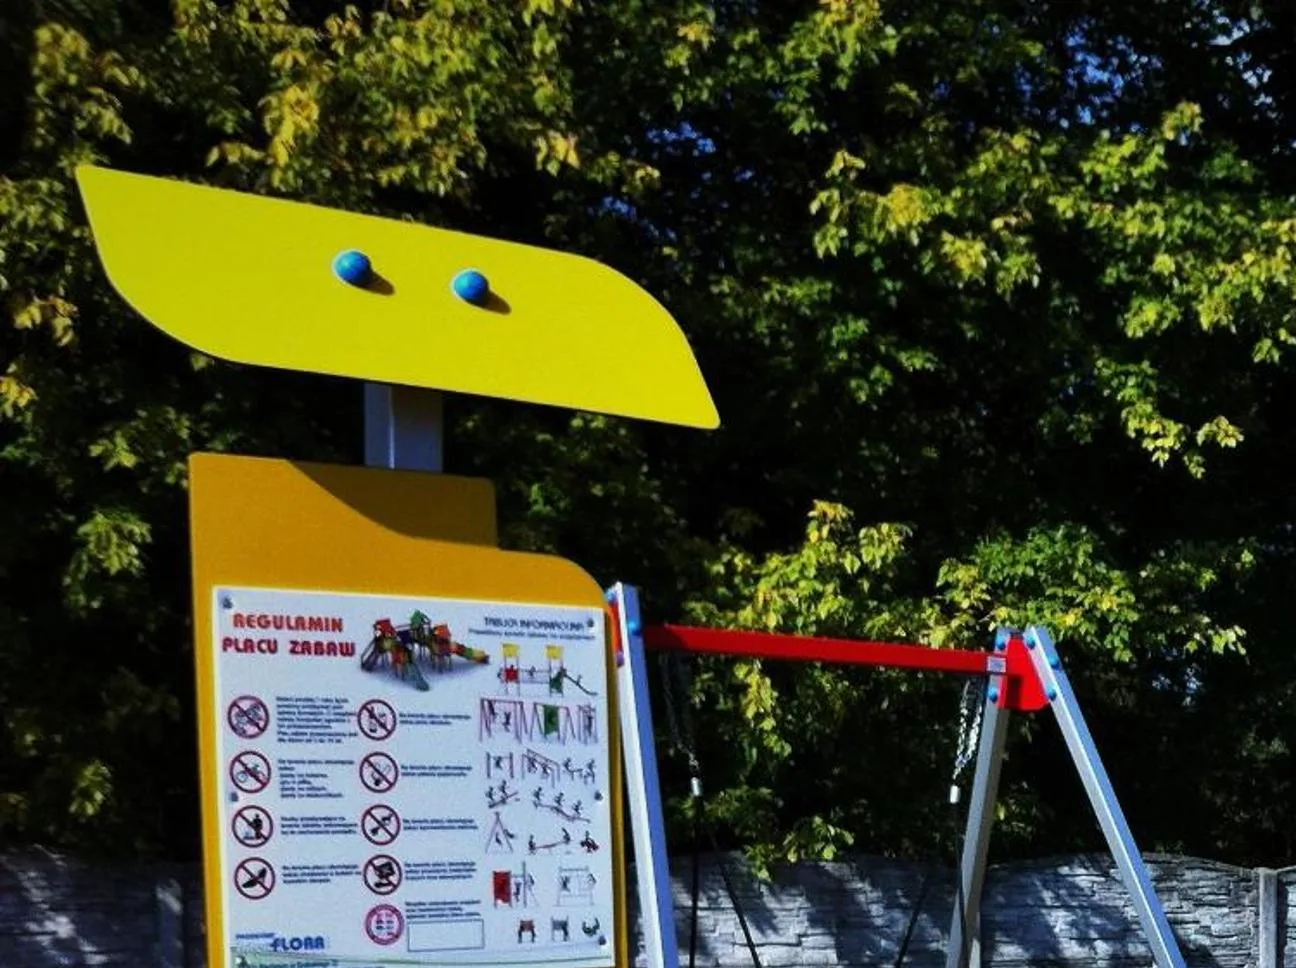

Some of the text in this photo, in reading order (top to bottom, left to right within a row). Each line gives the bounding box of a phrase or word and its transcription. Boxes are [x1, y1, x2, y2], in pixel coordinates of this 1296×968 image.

[233, 613, 343, 632] REGULAMIN
[222, 637, 356, 657] PLACU ZABAW
